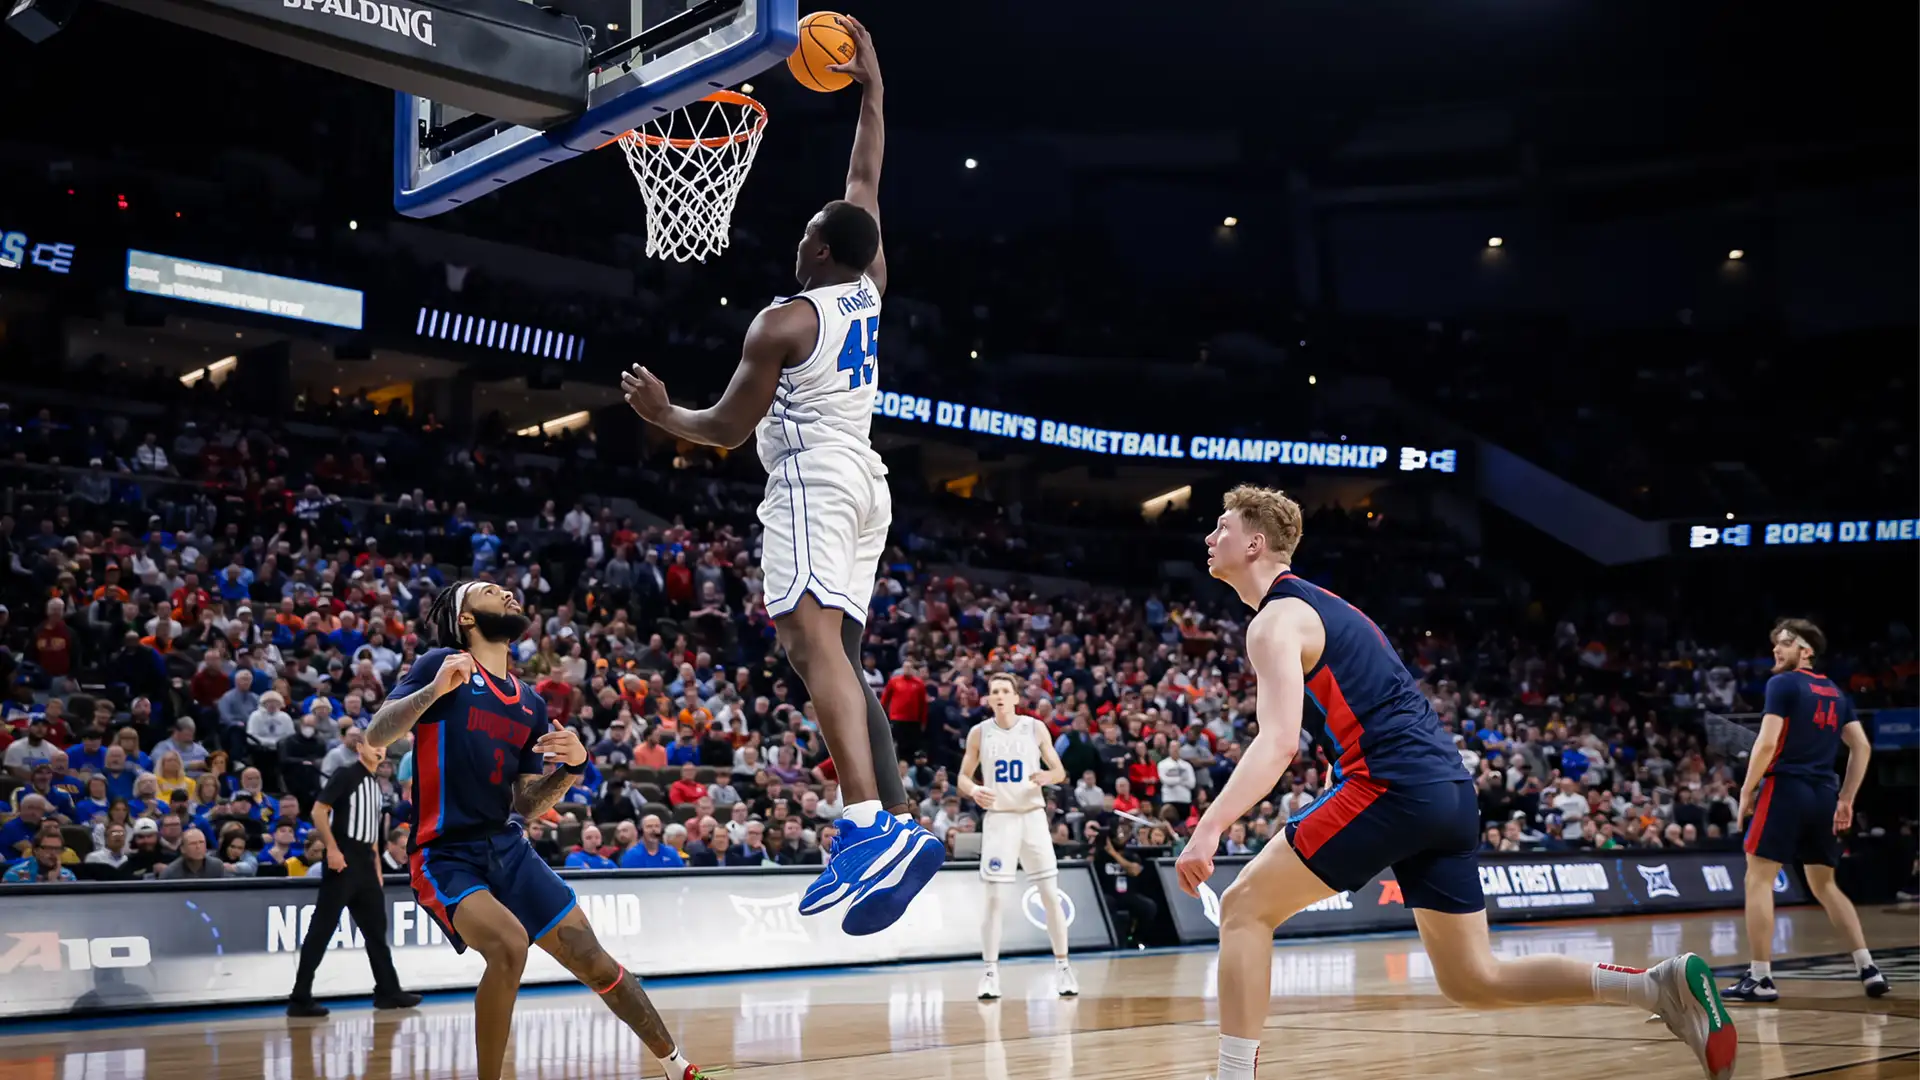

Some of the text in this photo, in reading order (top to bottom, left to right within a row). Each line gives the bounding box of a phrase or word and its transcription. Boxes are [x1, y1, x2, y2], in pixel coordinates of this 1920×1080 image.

[836, 315, 879, 390] 45
[872, 391, 1387, 468] 2024 DI MEN'S BASKETBALL CHAMPIONSHIP
[1764, 518, 1919, 545] 2024 DI ME
[1812, 699, 1839, 733] 44
[488, 748, 505, 785] 3
[994, 759, 1023, 783] 20
[1508, 864, 1557, 895] FIRST
